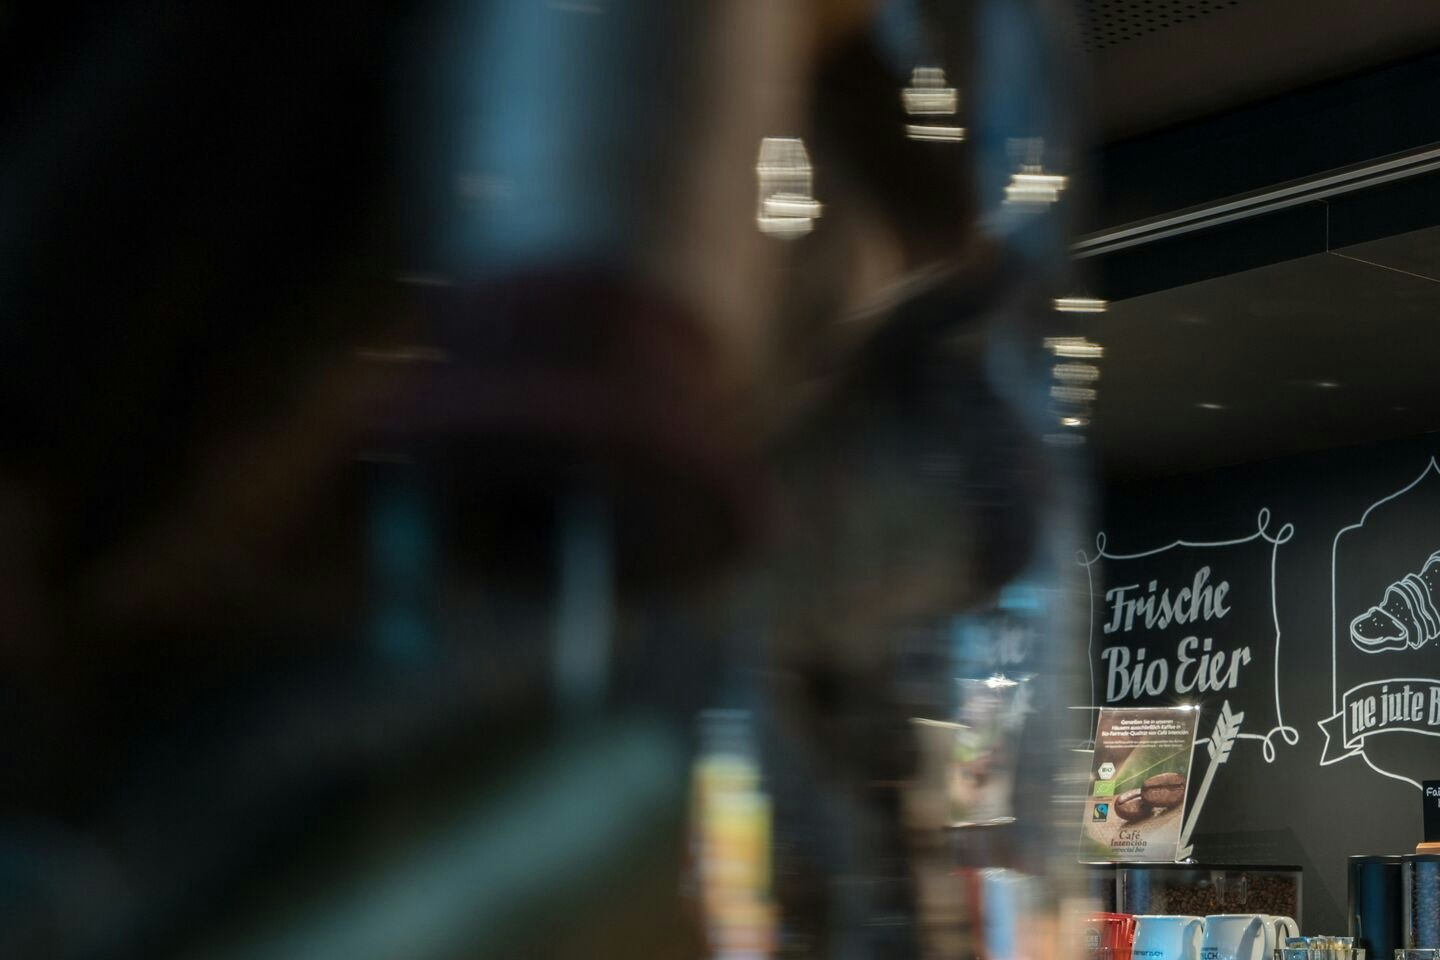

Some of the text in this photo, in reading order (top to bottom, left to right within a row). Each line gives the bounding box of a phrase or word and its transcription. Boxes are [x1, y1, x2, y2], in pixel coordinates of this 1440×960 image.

[1102, 565, 1232, 635] Frische
[1100, 635, 1252, 703] Bio Eier
[1379, 683, 1424, 733] jute
